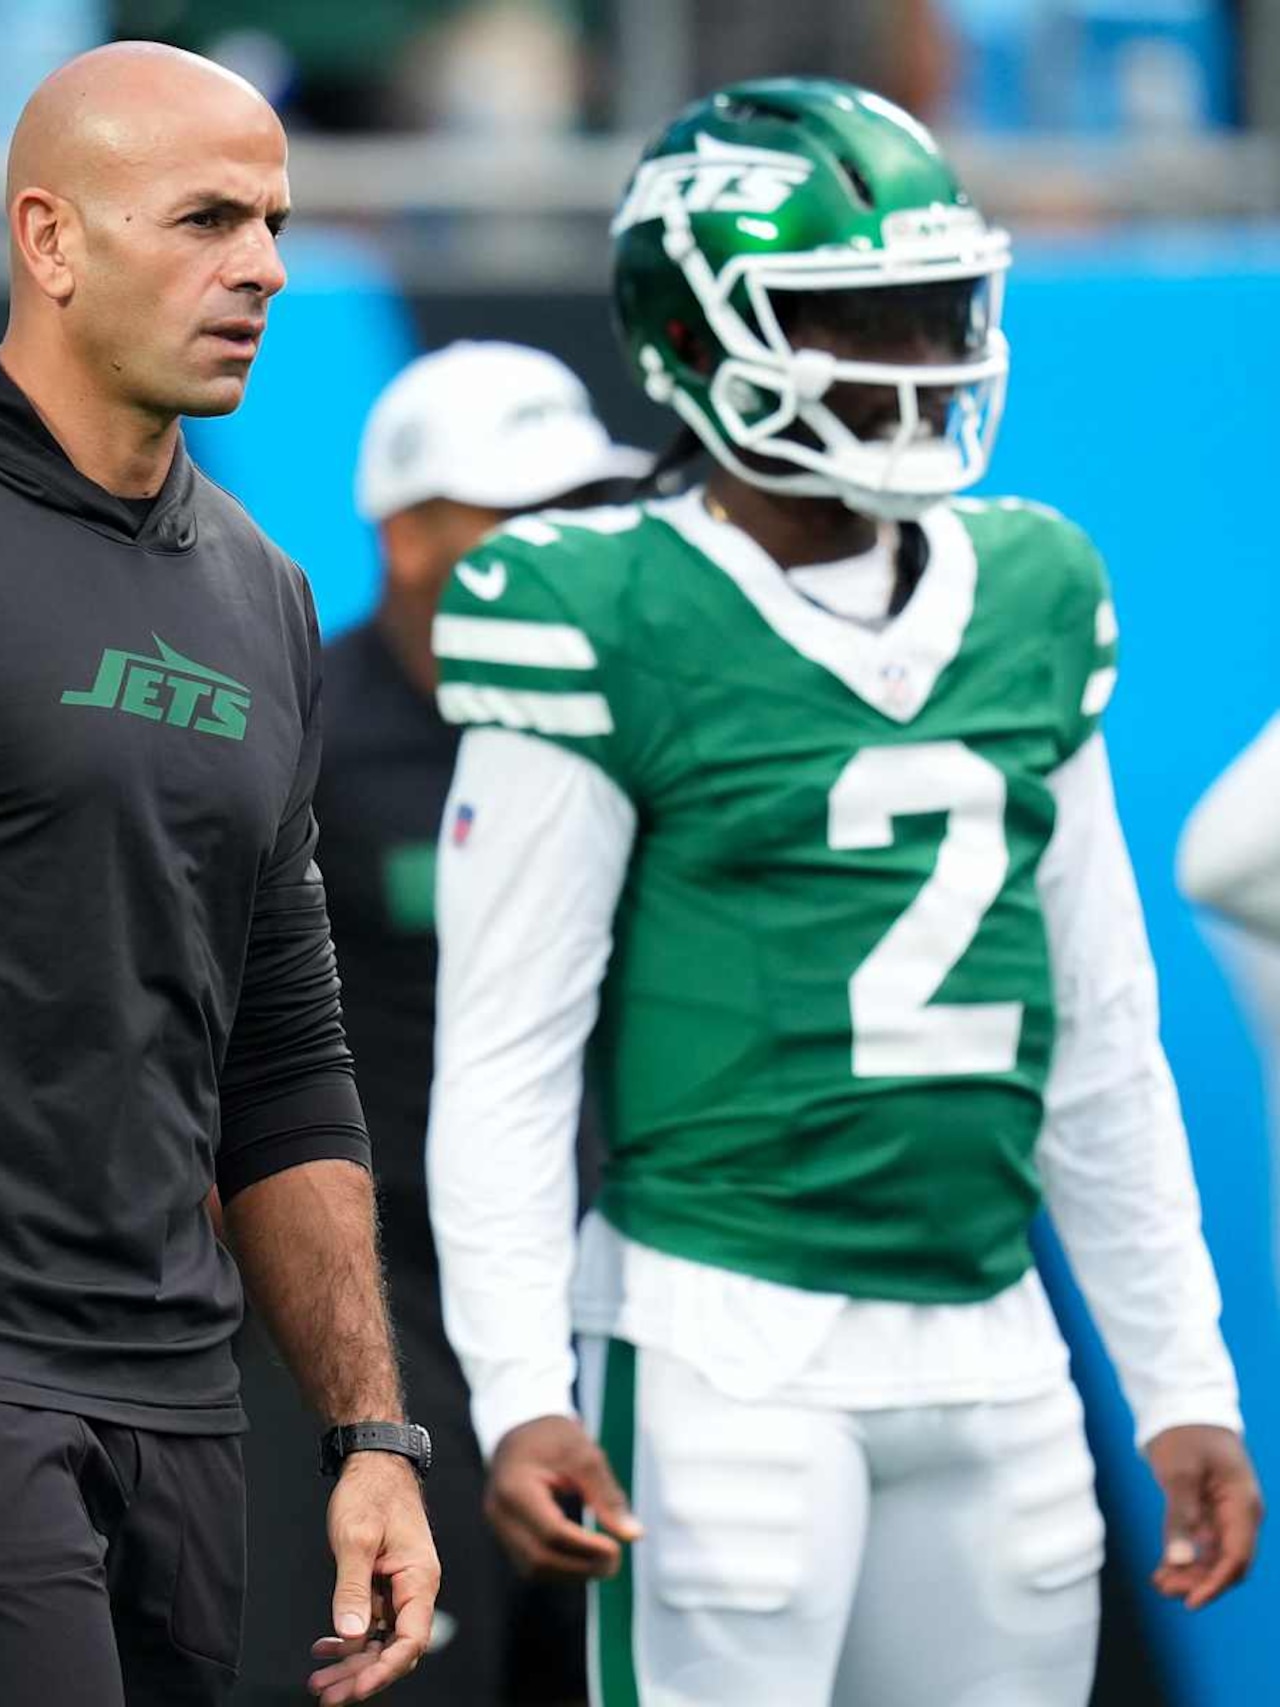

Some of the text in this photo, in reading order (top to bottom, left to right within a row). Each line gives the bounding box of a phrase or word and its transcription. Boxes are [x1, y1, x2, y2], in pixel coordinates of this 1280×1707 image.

[610, 132, 814, 235] JETS
[60, 630, 252, 741] JETS
[828, 740, 1023, 1076] 2
